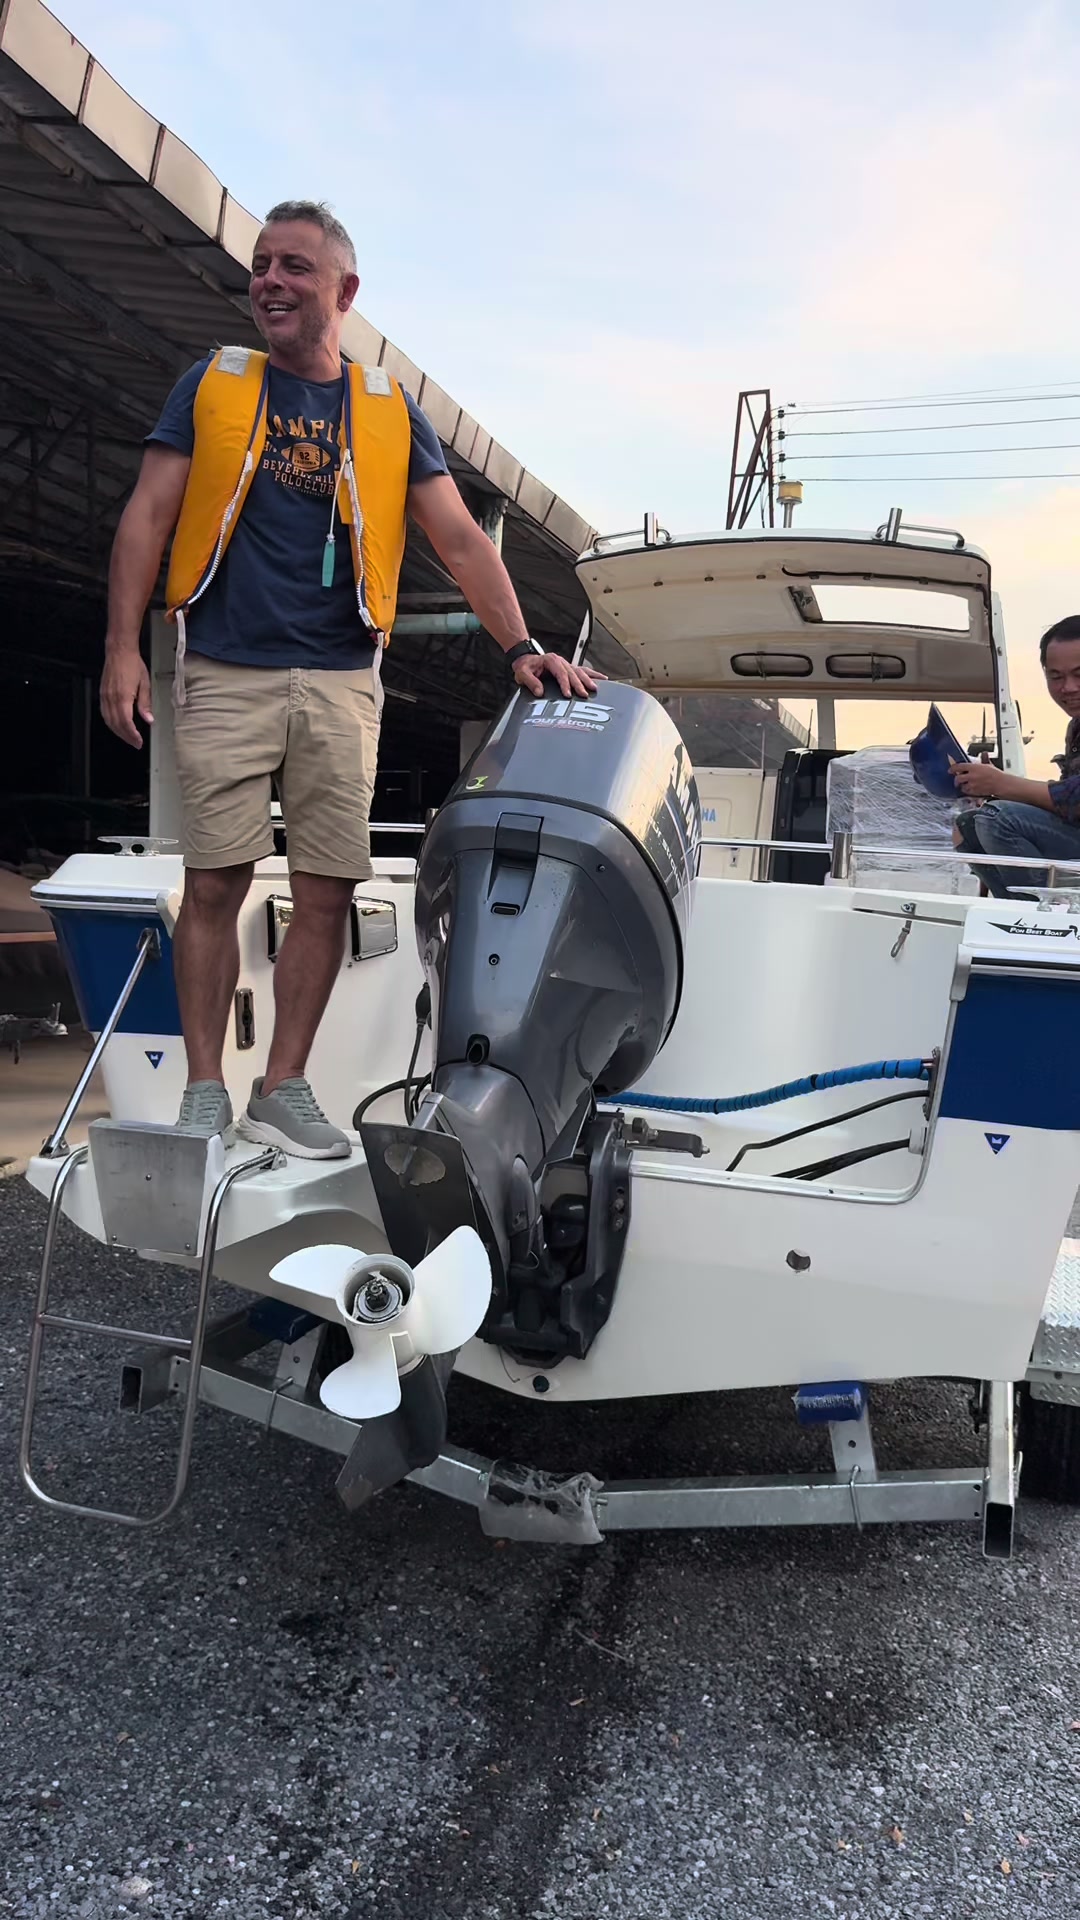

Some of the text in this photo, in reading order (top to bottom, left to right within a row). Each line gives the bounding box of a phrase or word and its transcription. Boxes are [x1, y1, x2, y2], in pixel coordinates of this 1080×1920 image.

[274, 471, 302, 487] POLO
[304, 479, 335, 495] CLUB
[530, 699, 615, 723] 115
